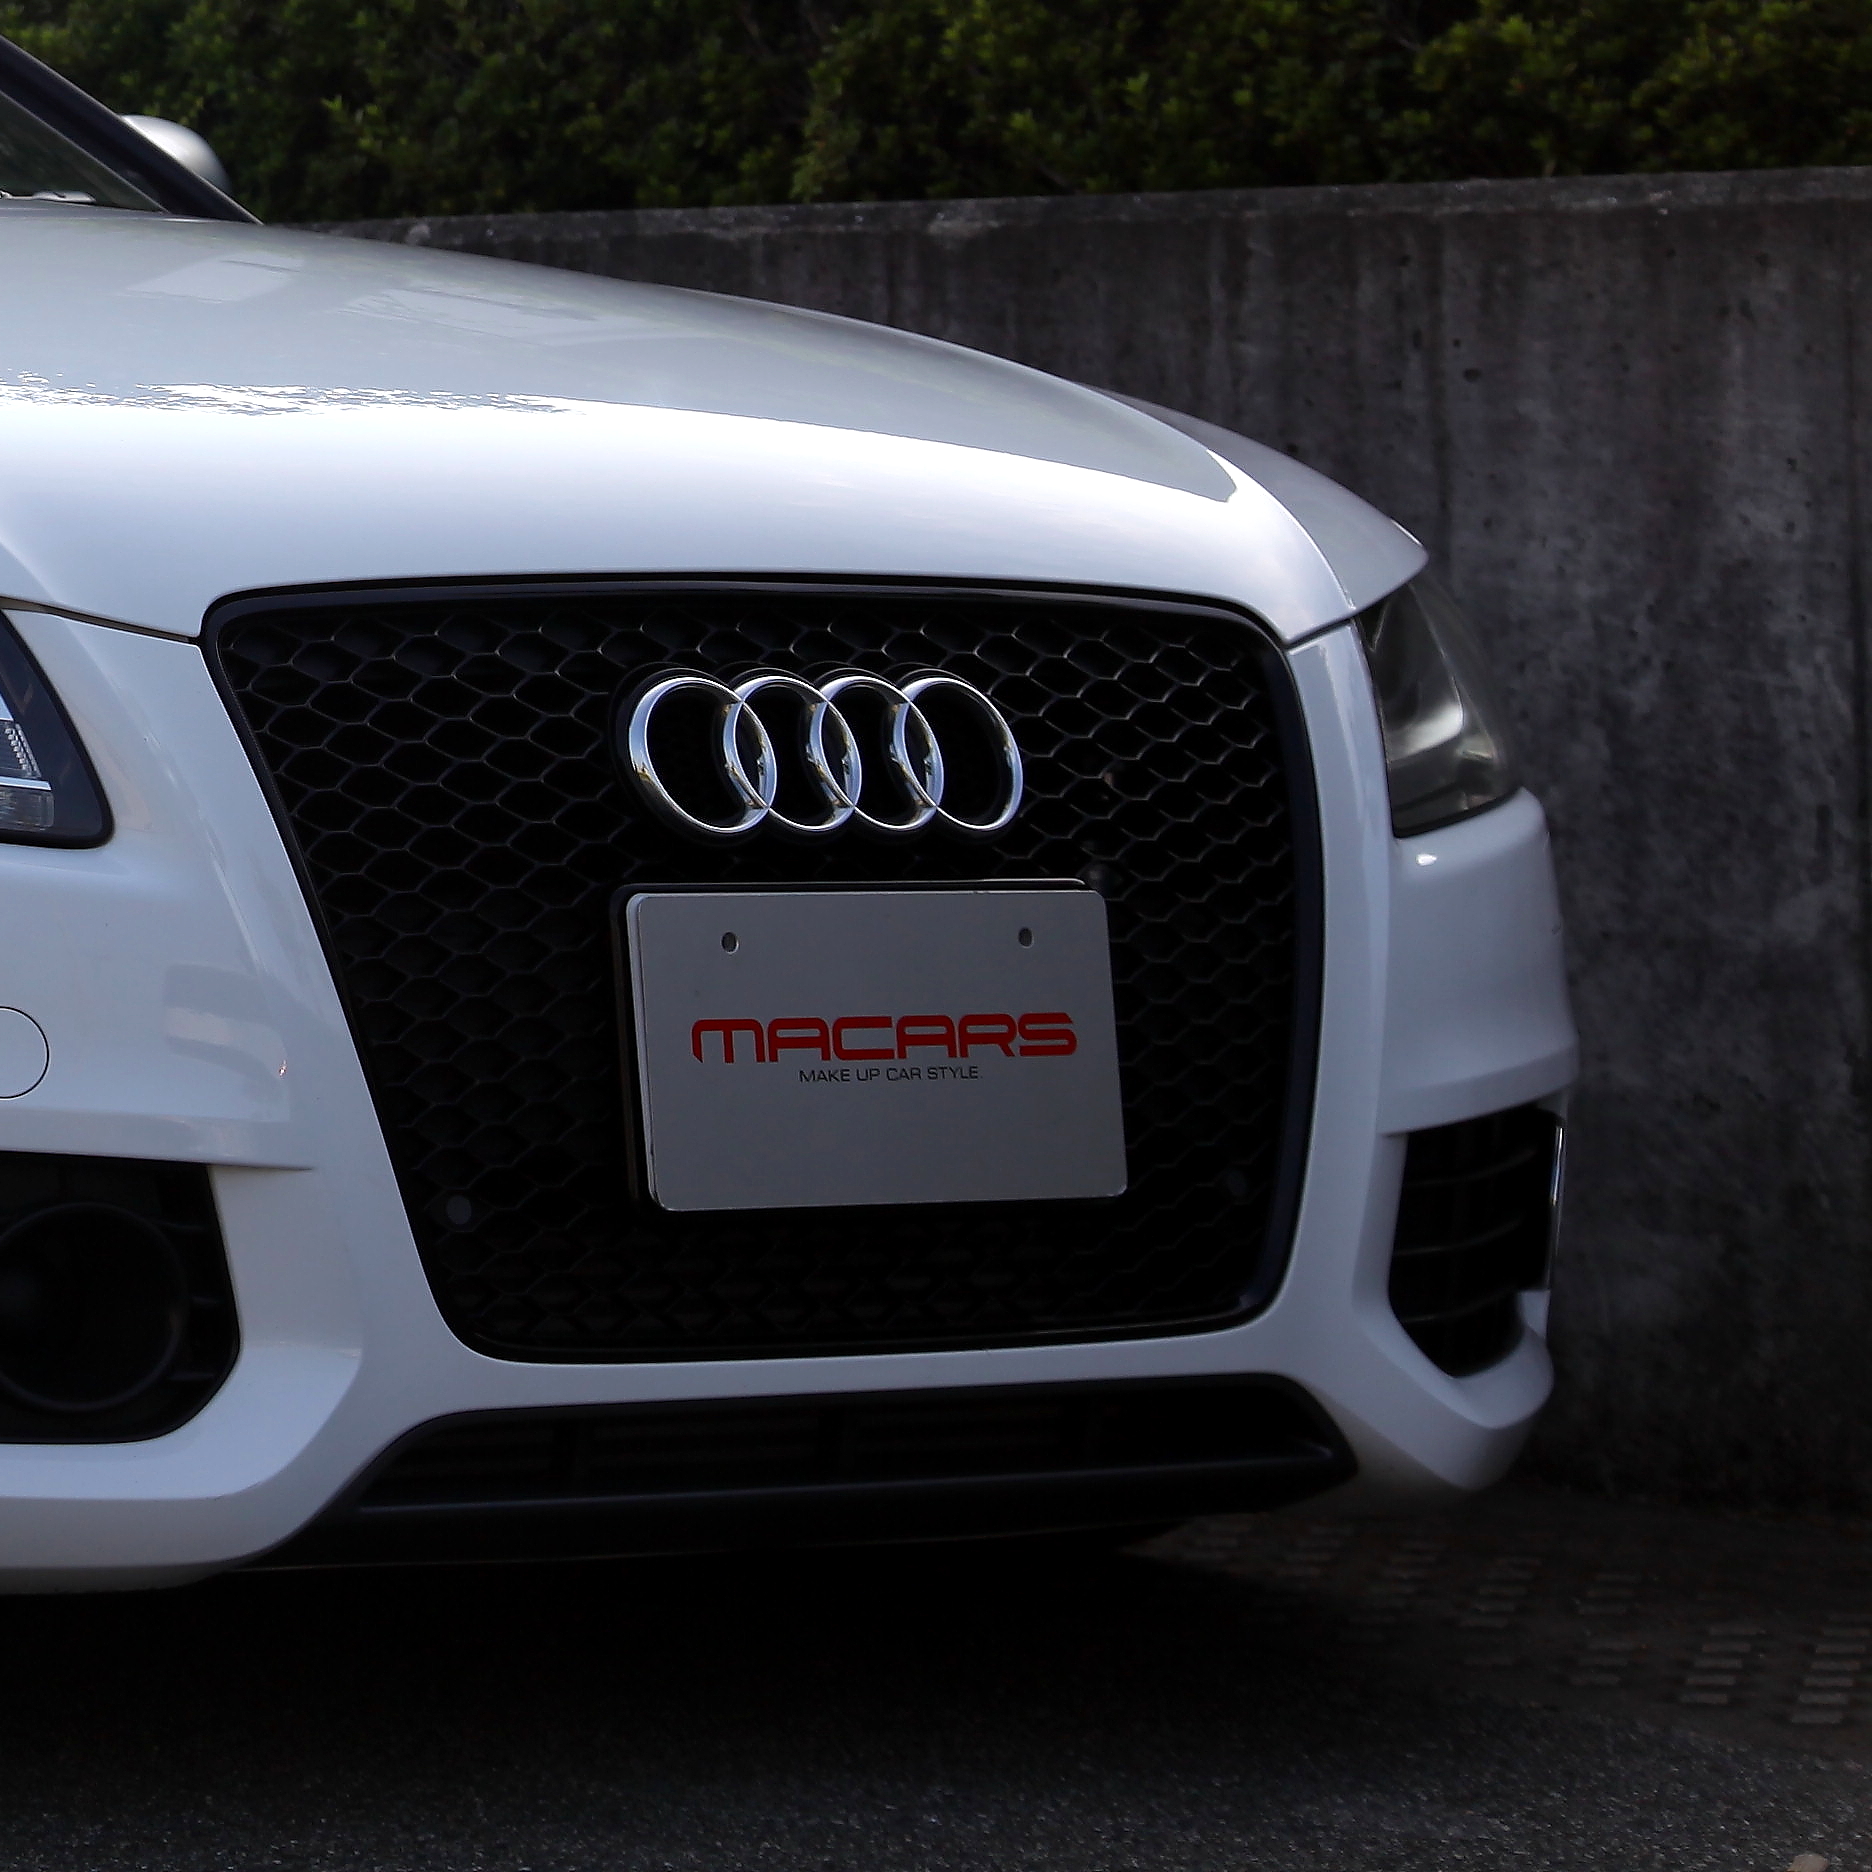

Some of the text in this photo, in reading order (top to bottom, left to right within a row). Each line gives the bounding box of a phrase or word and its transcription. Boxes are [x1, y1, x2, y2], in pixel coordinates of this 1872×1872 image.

[691, 1012, 1078, 1064] MACARS
[799, 1069, 850, 1083] MAKE
[856, 1068, 881, 1081] UP
[886, 1067, 922, 1081] CAR
